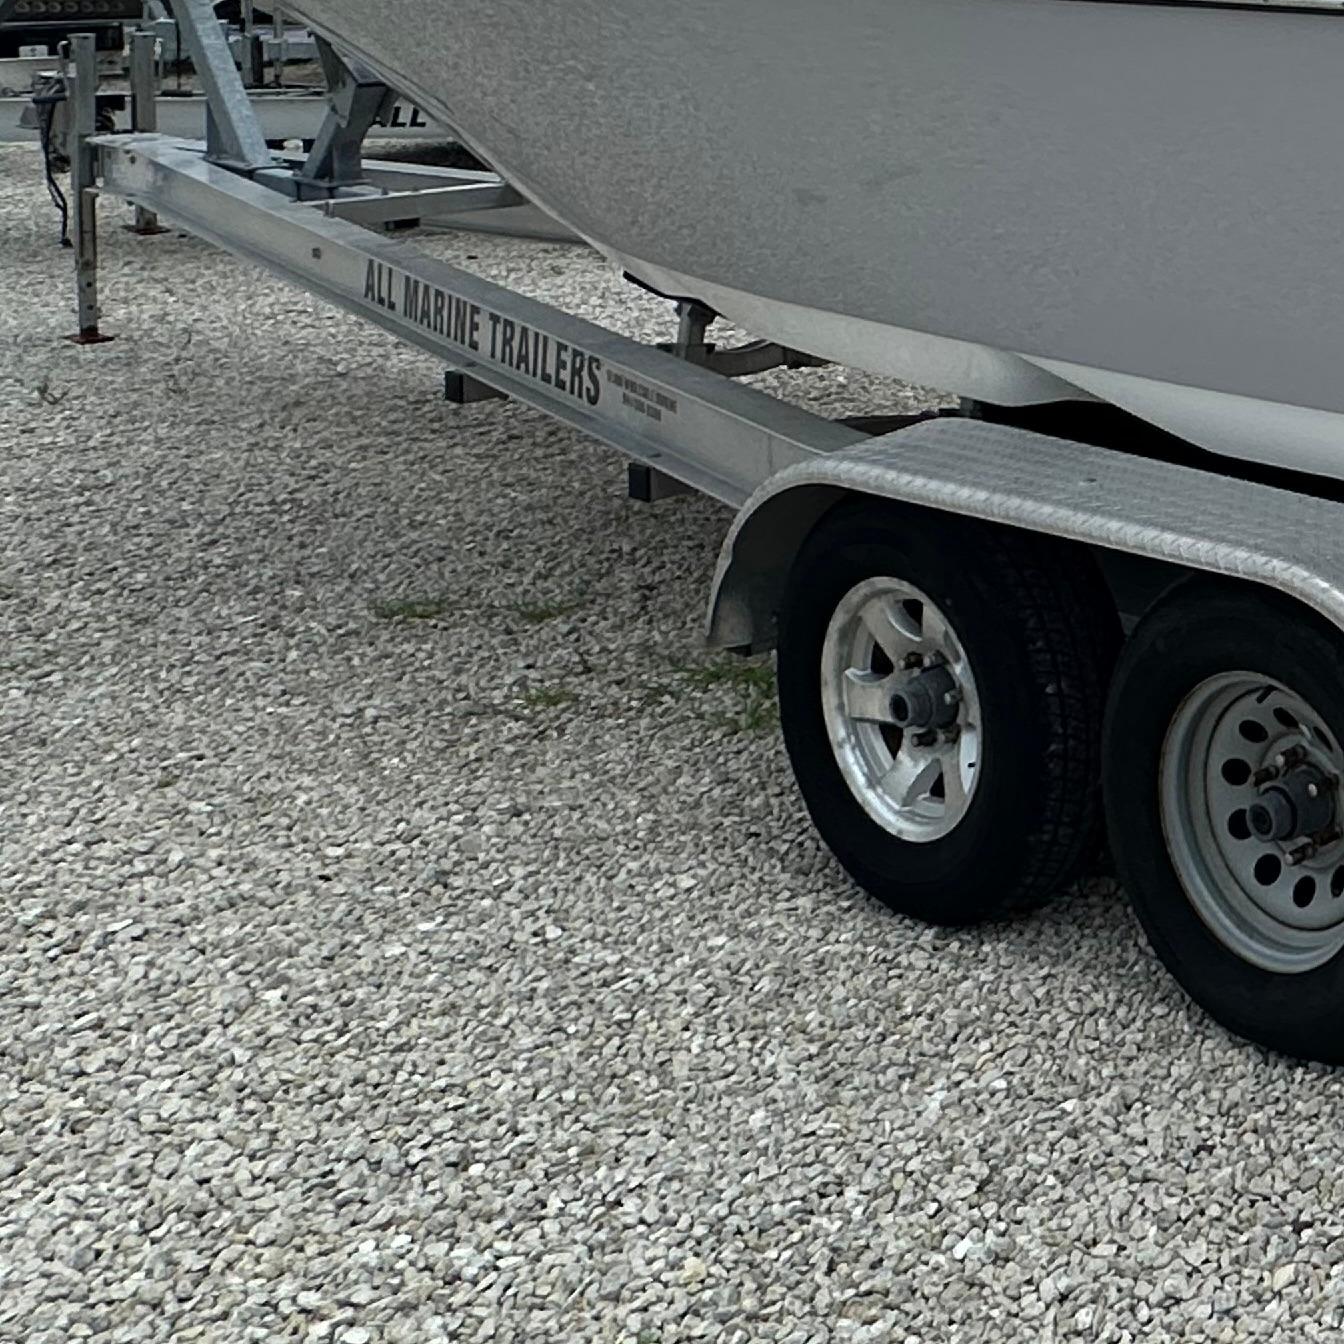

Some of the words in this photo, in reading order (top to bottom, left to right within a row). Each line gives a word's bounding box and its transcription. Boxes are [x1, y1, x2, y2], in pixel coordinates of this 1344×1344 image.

[364, 258, 396, 311] ALL
[403, 275, 481, 352] MARINE
[488, 312, 602, 406] TRAILERS
